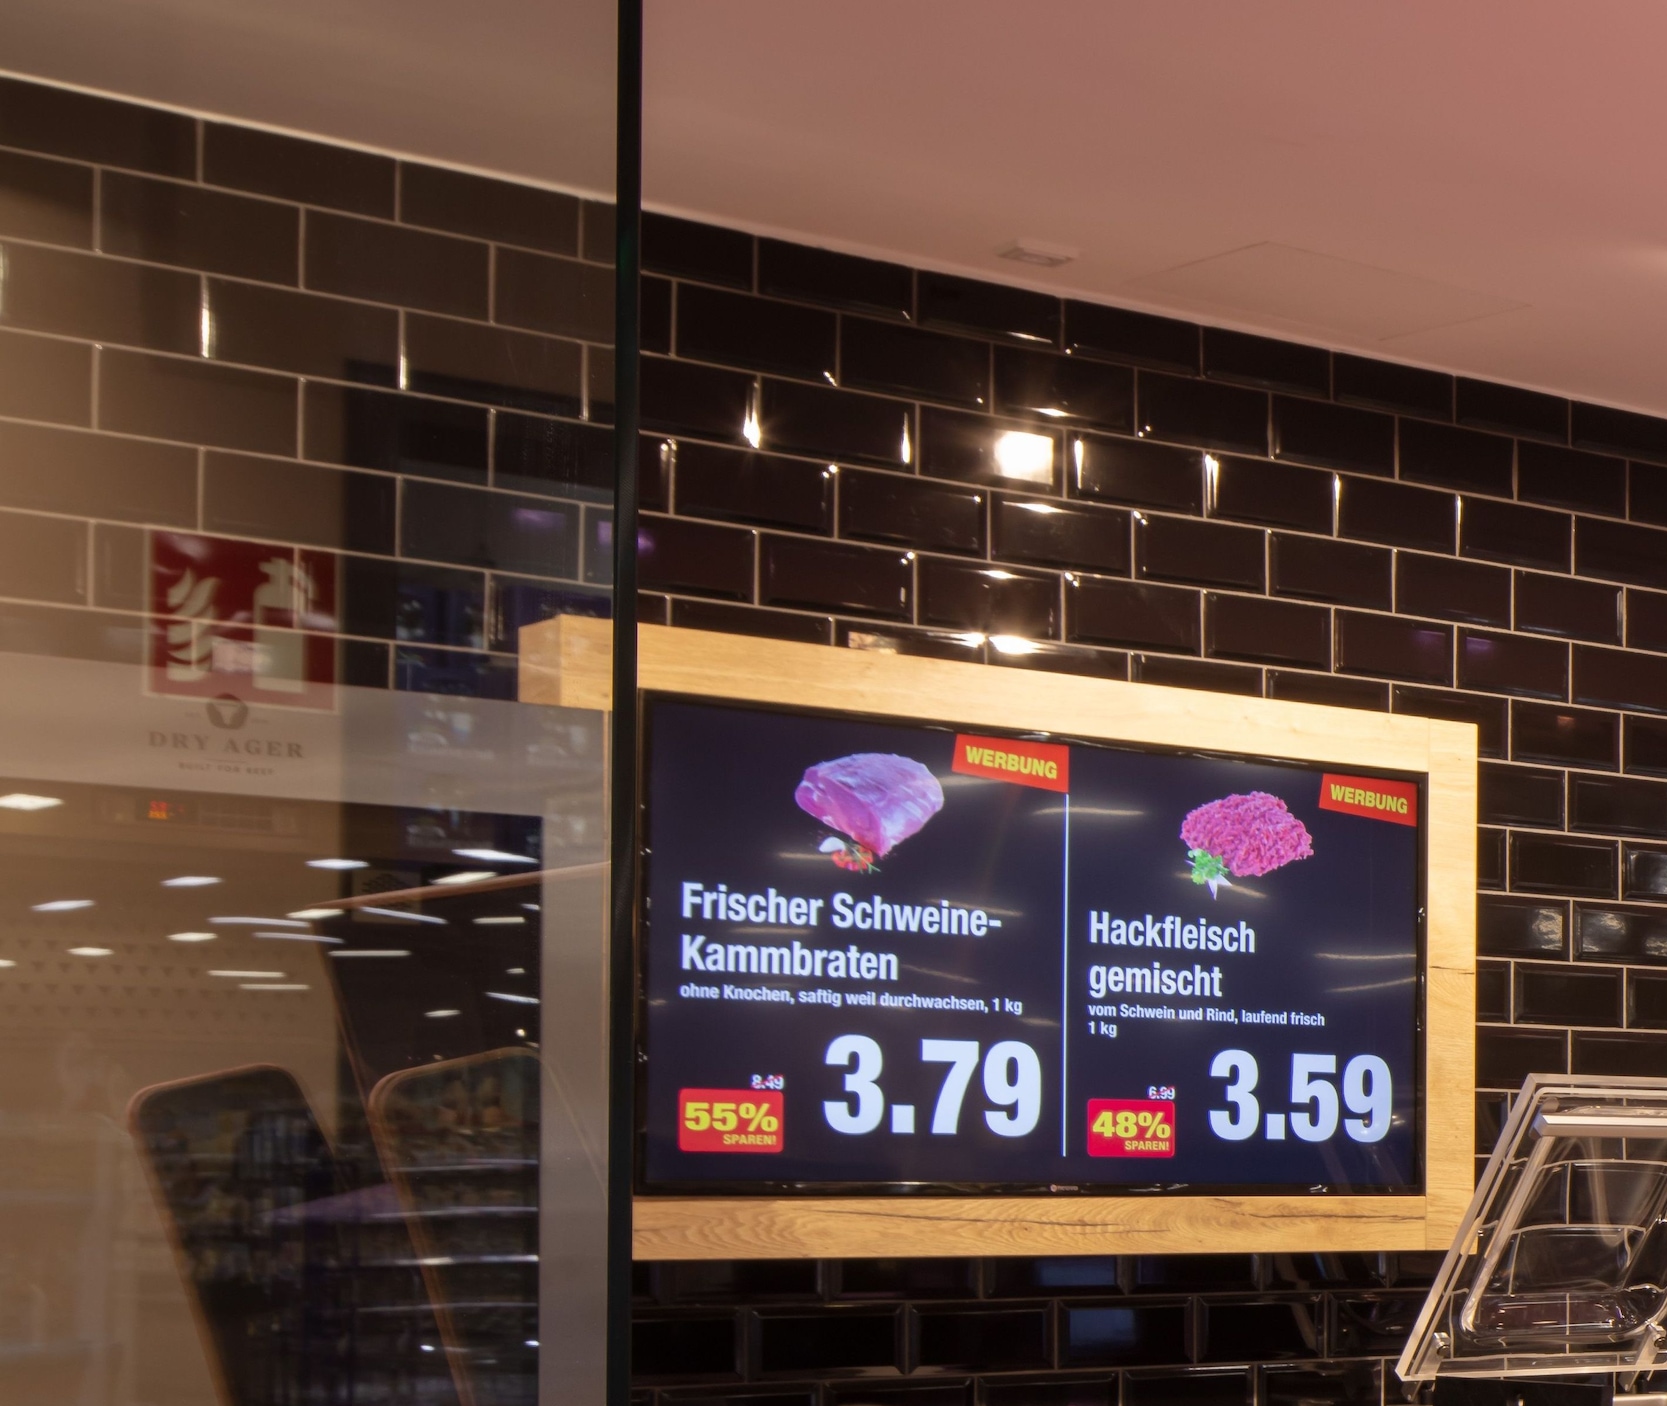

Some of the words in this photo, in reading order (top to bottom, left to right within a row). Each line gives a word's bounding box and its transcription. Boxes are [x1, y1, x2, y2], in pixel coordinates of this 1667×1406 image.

[149, 731, 209, 750] DRY
[224, 738, 305, 759] AGER
[964, 744, 1058, 781] WERBUNG
[1330, 783, 1408, 815] WERBUNG
[681, 881, 824, 926] Frischer
[832, 892, 1002, 936] Schweine-
[1089, 910, 1256, 953] Hackfleisch
[681, 934, 898, 981] Kammbraten
[1089, 962, 1222, 998] gemischt
[680, 984, 720, 999] ohne
[723, 984, 795, 1004] Knochen,
[798, 989, 842, 1007] saftig
[845, 991, 876, 1006] weil
[879, 993, 989, 1014] durchwachsen,
[992, 998, 999, 1011] 1
[1005, 999, 1022, 1015] kg
[1088, 1005, 1116, 1017] vom
[1119, 1004, 1175, 1020] Schwein
[1179, 1007, 1203, 1021] und
[1206, 1008, 1238, 1025] Rind,
[1241, 1009, 1287, 1025] laufend
[1290, 1011, 1325, 1027] frisch
[1088, 1022, 1095, 1034] 1
[1100, 1021, 1117, 1038] kg
[751, 1075, 784, 1090] 8.49
[823, 1034, 1042, 1137] 3.79
[1148, 1085, 1175, 1100] 6.99
[1208, 1048, 1393, 1143] 3.59
[684, 1102, 778, 1132] 55%
[1092, 1111, 1171, 1138] 48%
[723, 1133, 777, 1145] SPAREN!
[1125, 1139, 1169, 1151] SPAREN!
